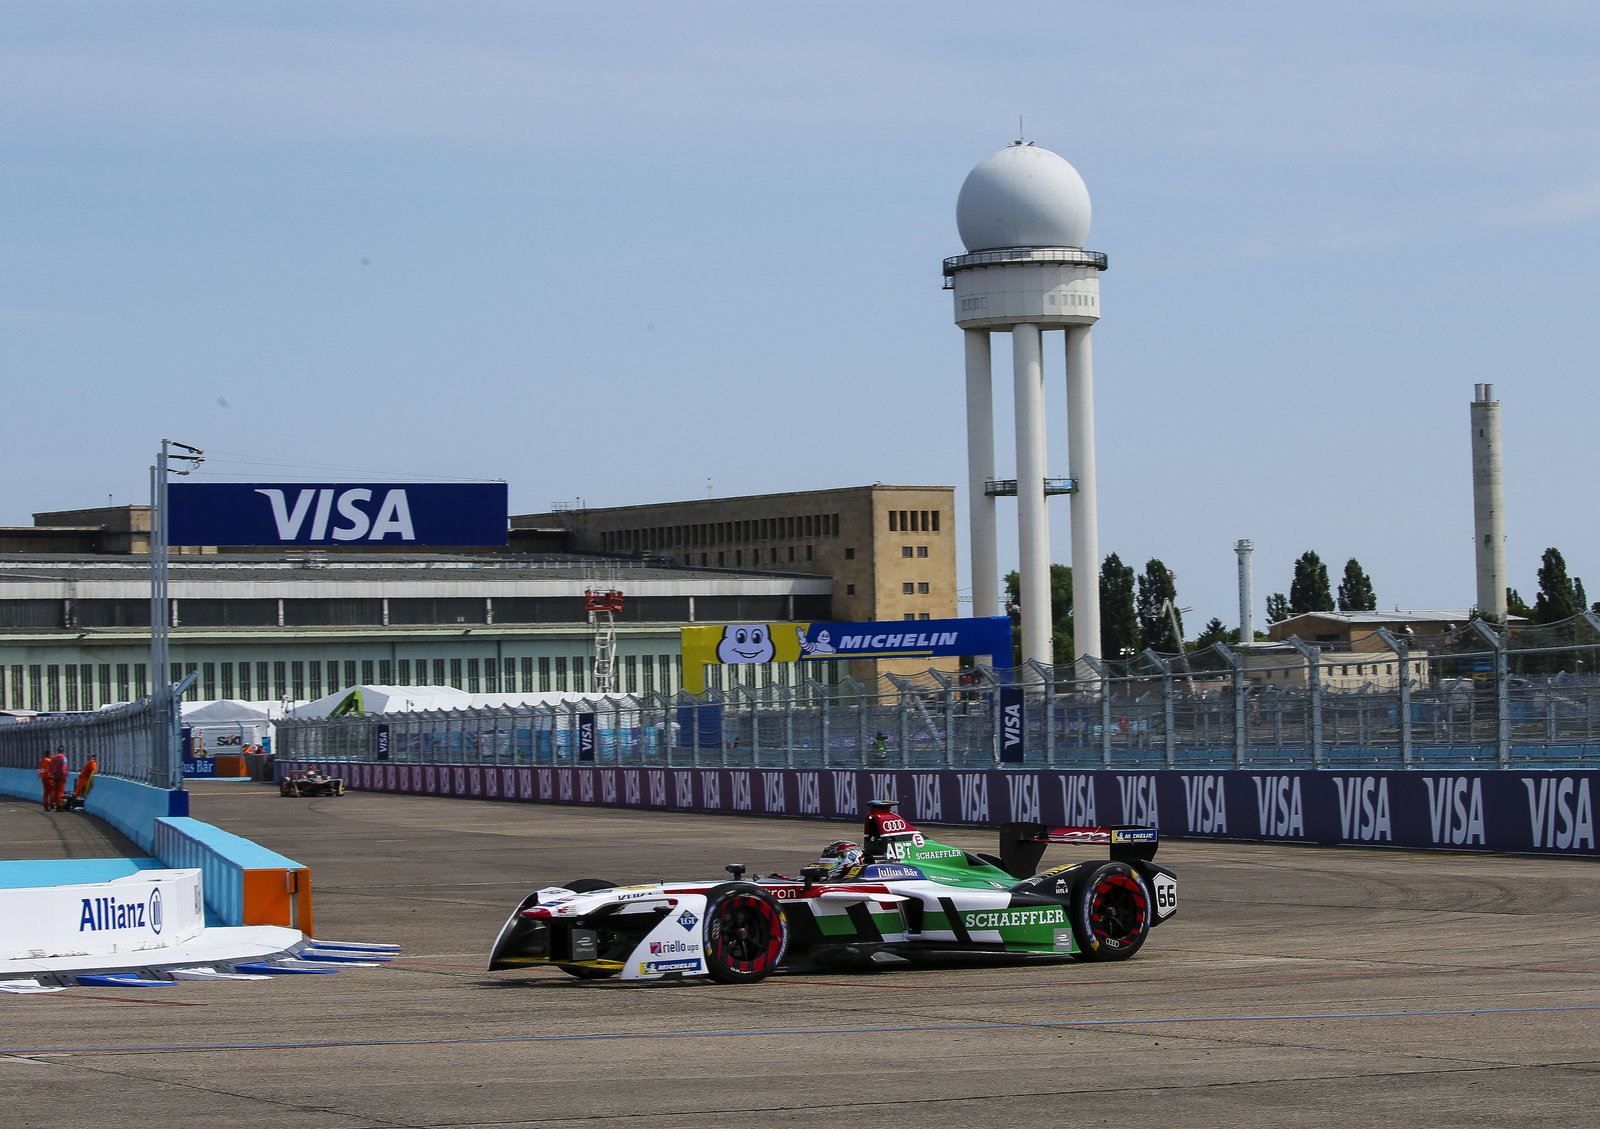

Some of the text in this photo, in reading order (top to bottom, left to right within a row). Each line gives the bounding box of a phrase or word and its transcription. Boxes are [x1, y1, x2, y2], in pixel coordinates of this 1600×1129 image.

[254, 488, 416, 540] VISA
[839, 631, 959, 649] MICHELIN
[379, 731, 388, 753] VISA
[579, 723, 593, 751] VISA
[1004, 704, 1021, 750] VISA
[196, 758, 214, 773] Bär
[730, 771, 751, 810] VISA
[762, 771, 784, 812] VISA
[796, 771, 820, 813] VISA
[832, 770, 857, 814] VISA
[912, 773, 941, 819] VISA
[957, 772, 989, 821] VISA
[1006, 774, 1040, 823] VISA
[1059, 774, 1096, 827] VISA
[1116, 775, 1158, 829] VISA
[1181, 774, 1226, 833] VISA
[1252, 775, 1304, 836] VISA
[1333, 776, 1391, 840] VISA
[1423, 776, 1485, 844] VISA
[1521, 776, 1594, 849] VISA
[886, 842, 912, 860] ABT
[915, 849, 962, 860] SCHAEFFLER
[878, 867, 918, 878] Julius Bär
[80, 896, 146, 932] Allianz
[1158, 884, 1176, 908] 66
[680, 917, 697, 926] LGT
[965, 909, 1065, 928] SCHAEFFLER
[657, 962, 698, 971] MICHELIN
[663, 940, 700, 954] riello ups
